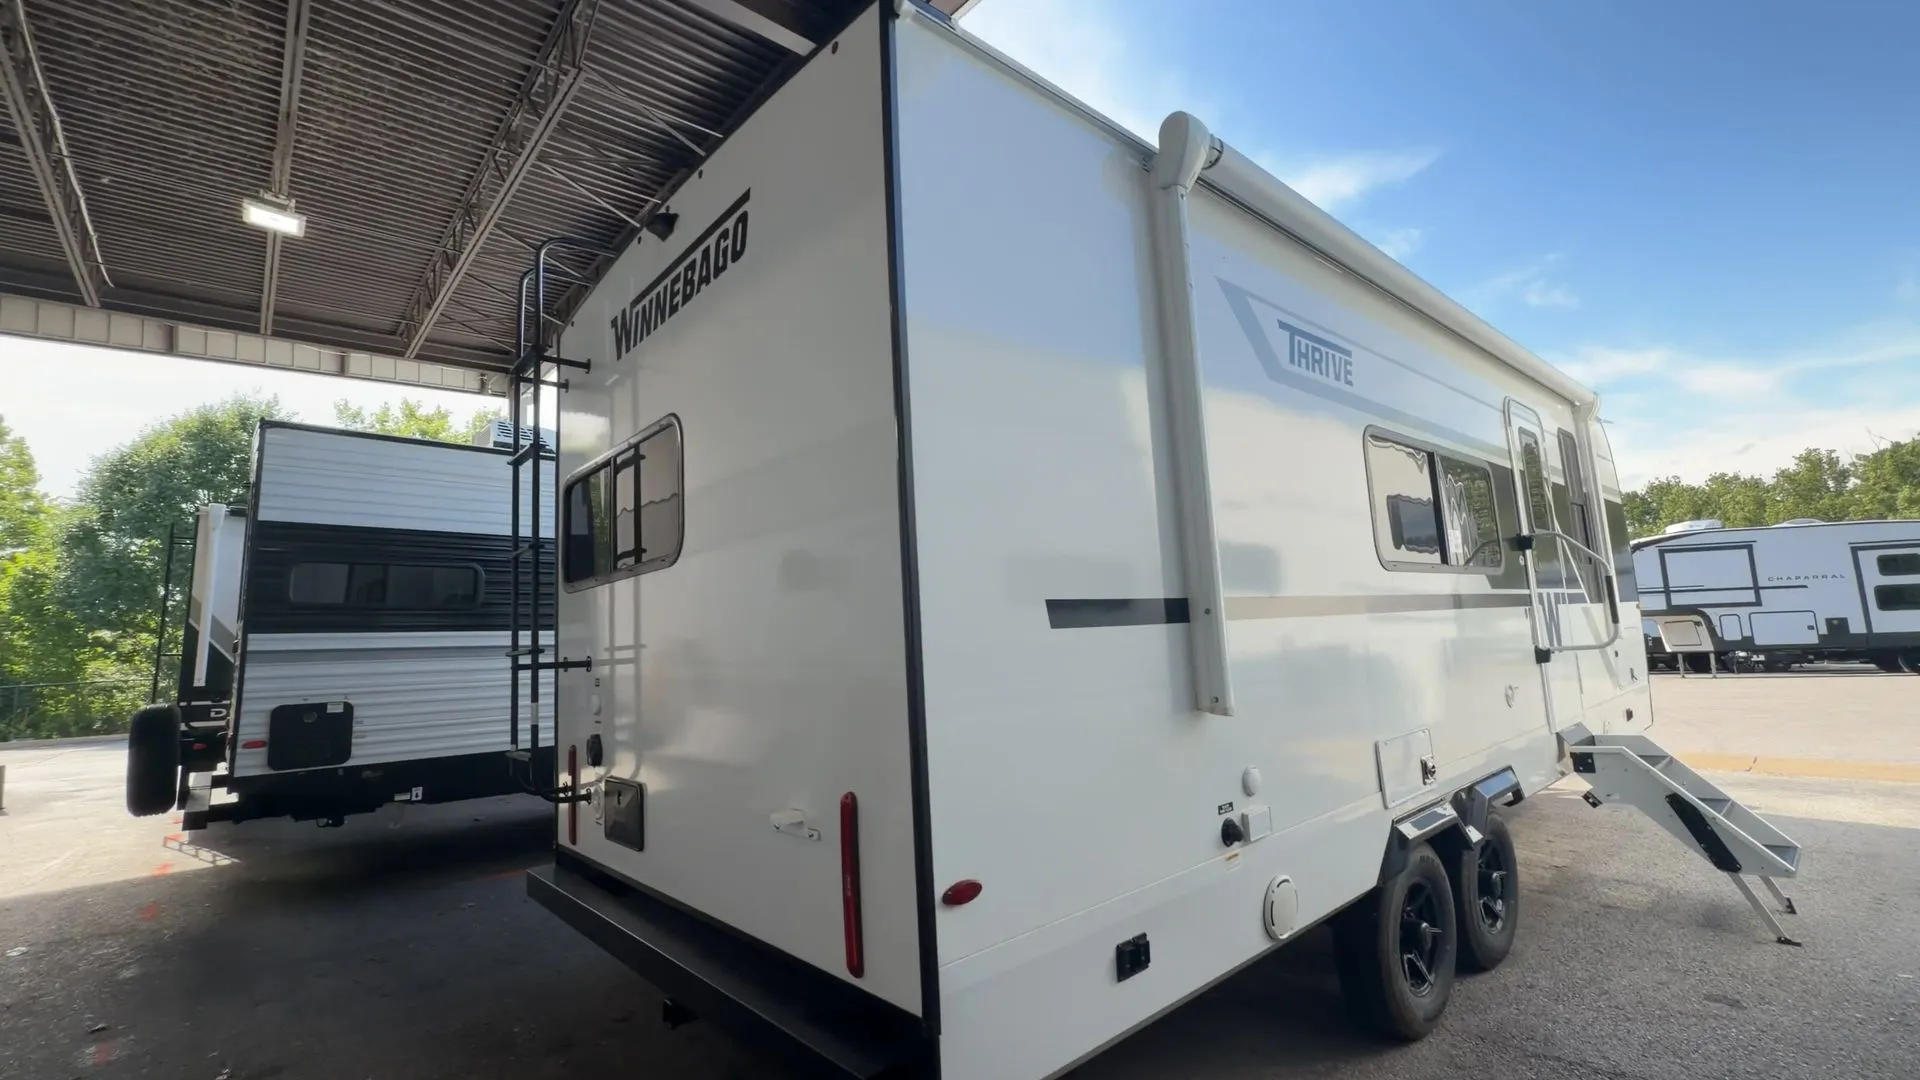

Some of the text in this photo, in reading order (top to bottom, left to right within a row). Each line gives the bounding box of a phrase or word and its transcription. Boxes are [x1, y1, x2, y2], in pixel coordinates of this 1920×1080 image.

[611, 187, 751, 361] WINNEBAGO
[1277, 318, 1354, 387] THRIVE
[1767, 573, 1846, 582] CHAPARRAL
